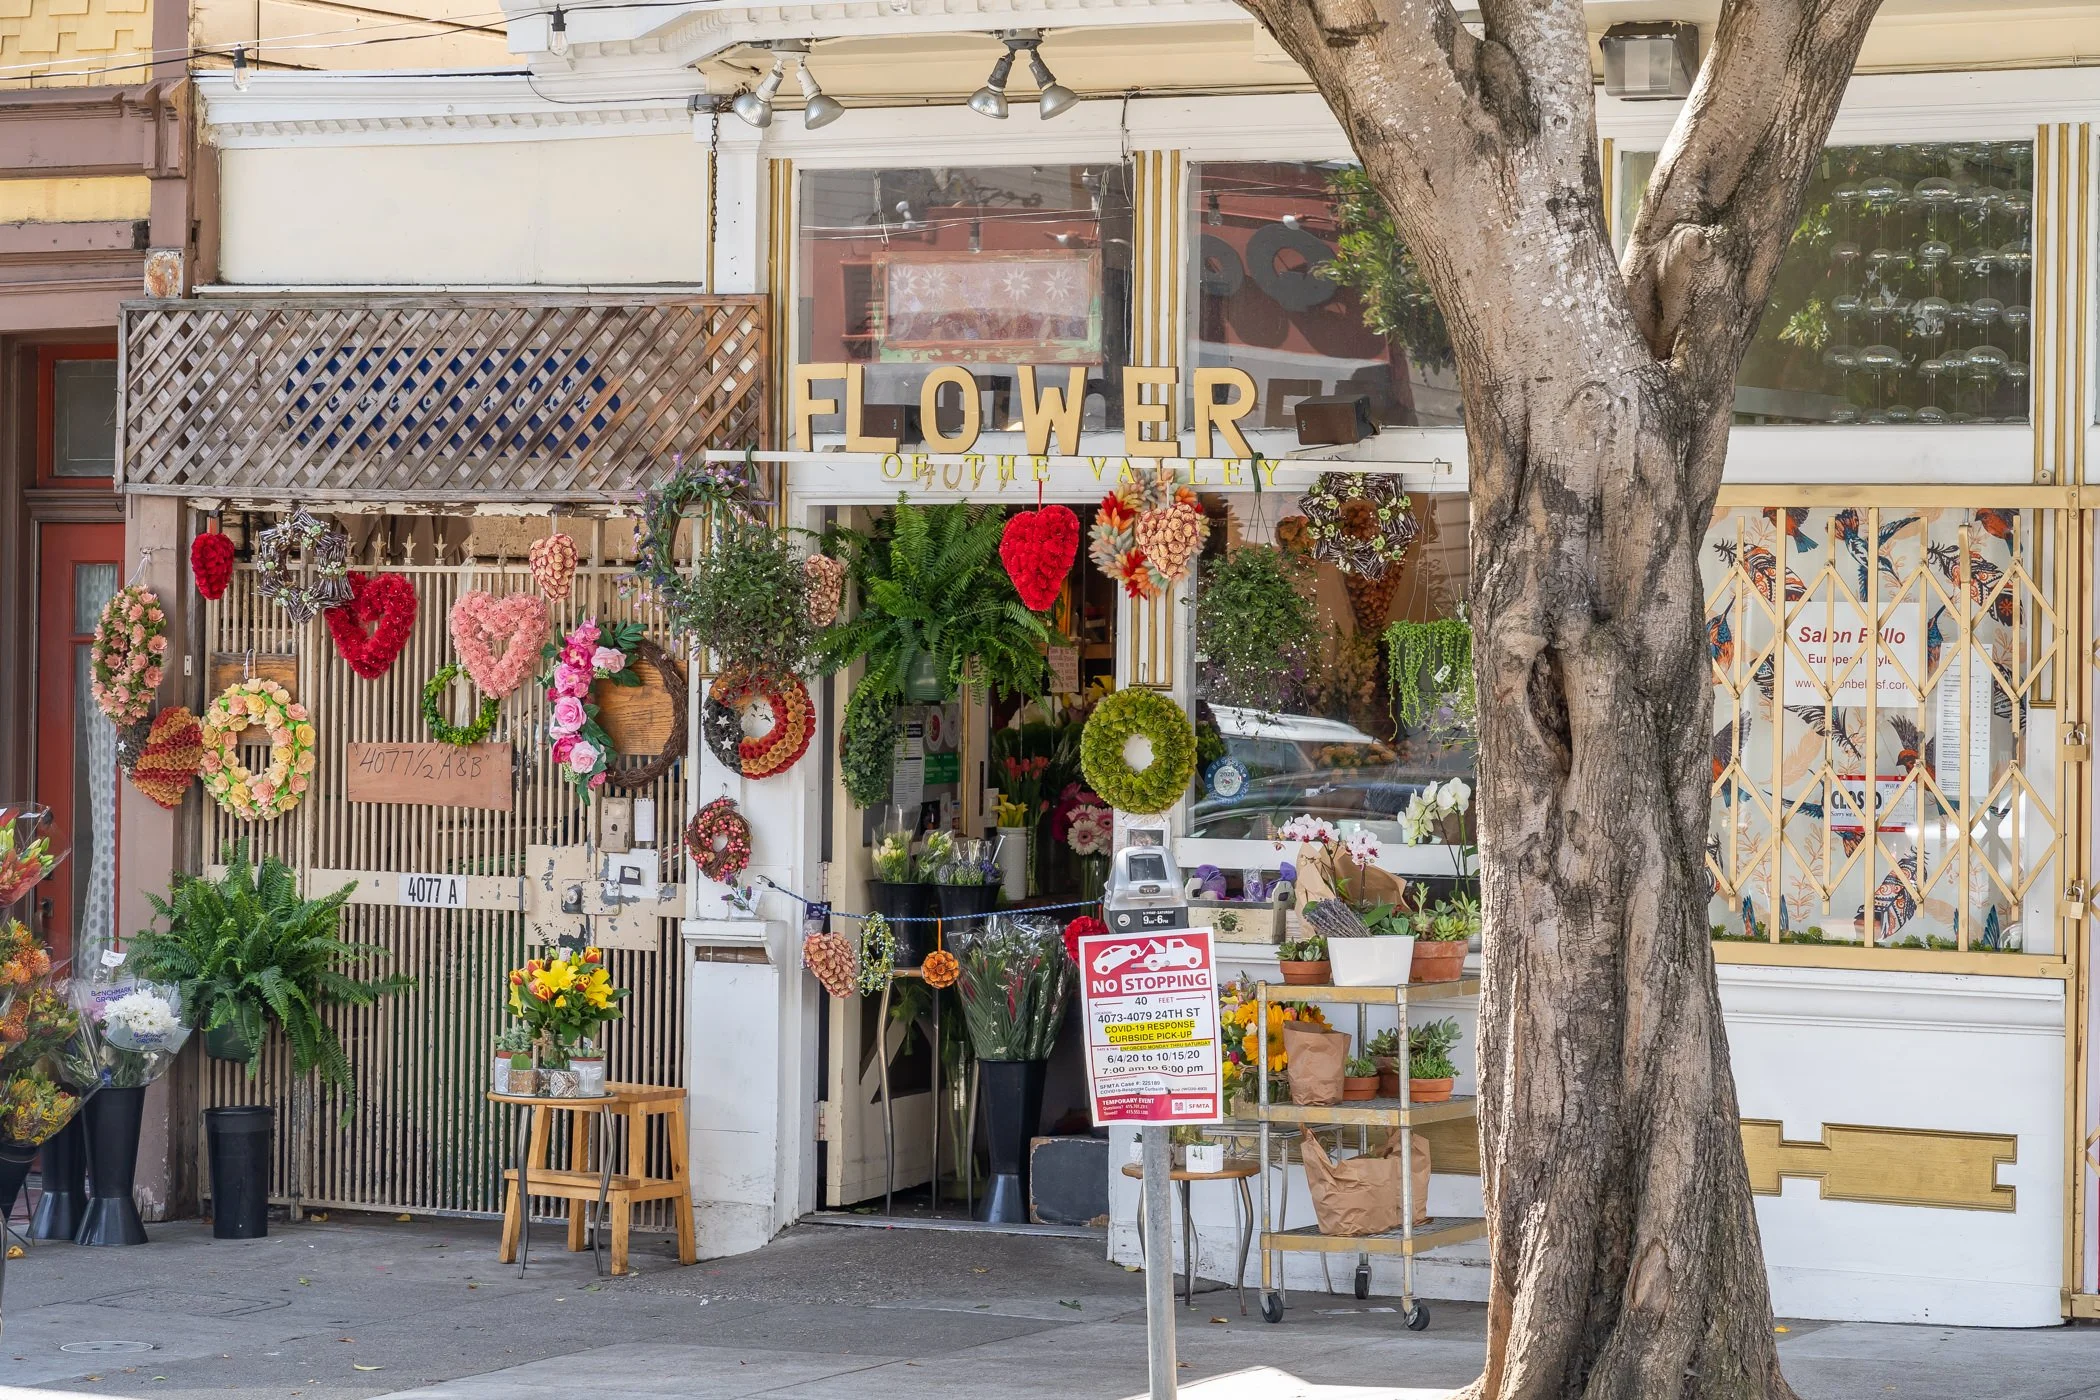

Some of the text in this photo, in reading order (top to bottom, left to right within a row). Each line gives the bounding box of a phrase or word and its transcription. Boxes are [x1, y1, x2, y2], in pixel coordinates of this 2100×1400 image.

[796, 362, 1258, 458] FLOWER
[881, 453, 1280, 487] OF THE VALLEY
[1798, 626, 1906, 644] Salon Bllo
[1808, 653, 1863, 667] Eurpen
[359, 747, 413, 776] 4077
[1831, 790, 1882, 809] CLOSD
[408, 877, 458, 904] 4077 A
[1092, 973, 1207, 994] NO STOPPING
[1134, 996, 1174, 1006] 40 FEET
[1097, 1007, 1201, 1023] 4073-4079 24TH ST
[1104, 1020, 1196, 1034] COVID-19 RESPONSE
[1108, 1030, 1192, 1043] CURBSIDE PICK-UP
[1107, 1049, 1200, 1064] 6/4/20 to 10/15/20
[1102, 1066, 1125, 1075] 7:00
[1161, 1064, 1184, 1074] 6:00
[1187, 1064, 1204, 1075] pm
[1102, 1098, 1138, 1106] TEMPORARY
